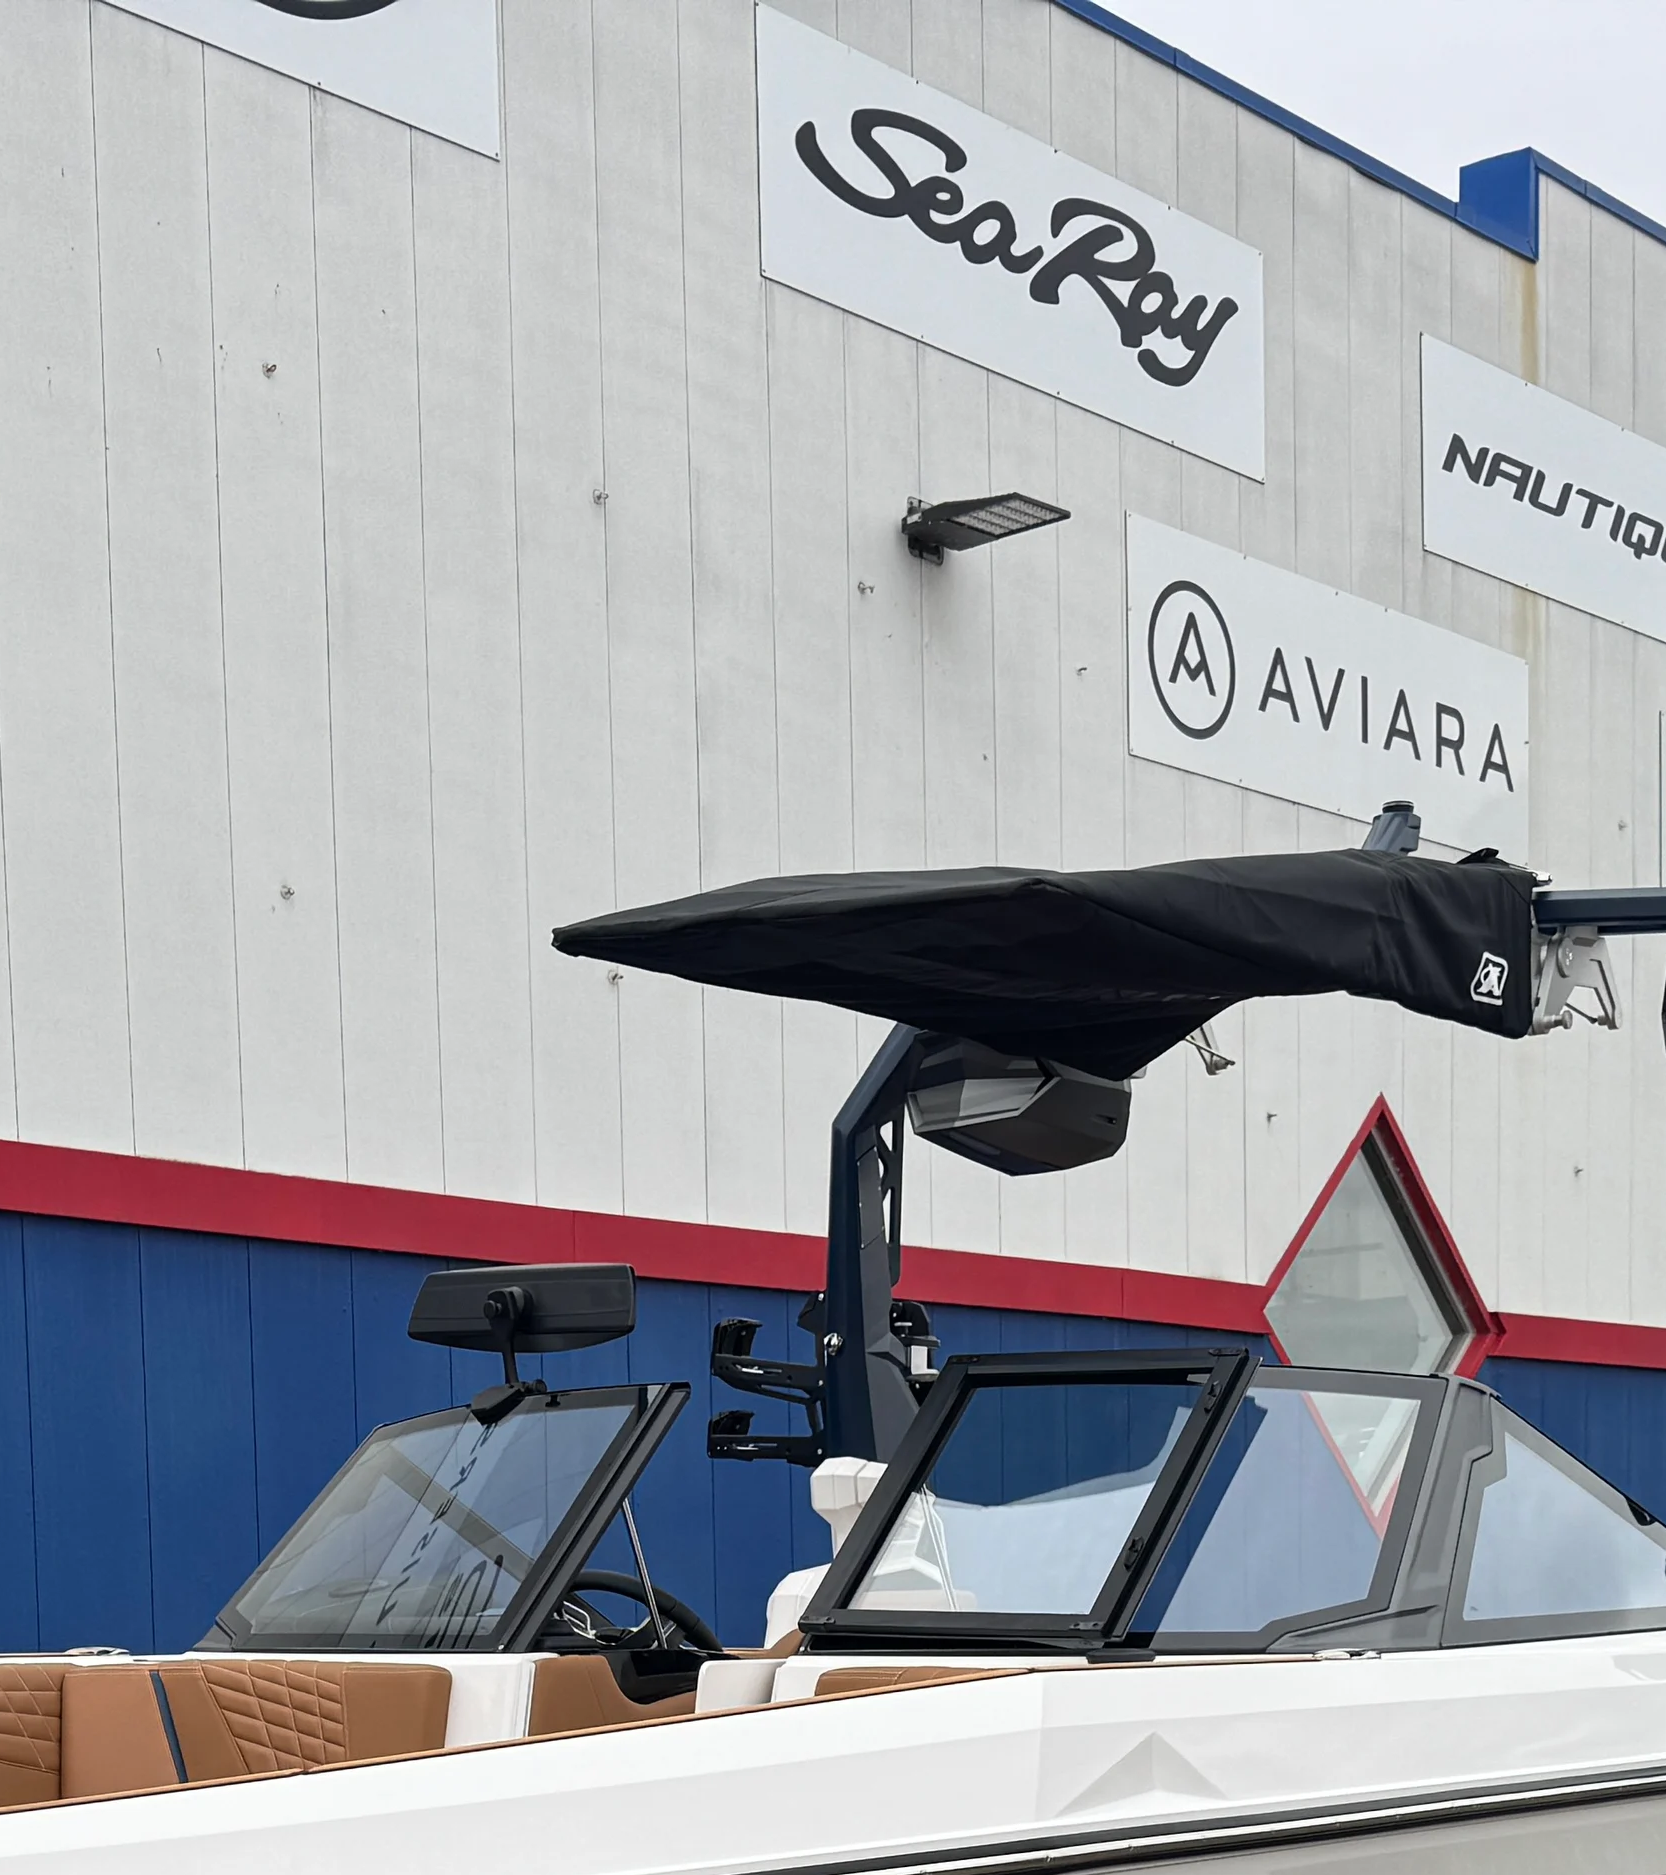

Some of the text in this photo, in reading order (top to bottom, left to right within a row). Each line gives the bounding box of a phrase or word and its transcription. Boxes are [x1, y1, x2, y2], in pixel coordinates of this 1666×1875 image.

[795, 108, 1239, 387] Sea Ray
[1257, 646, 1514, 793] AVIARA
